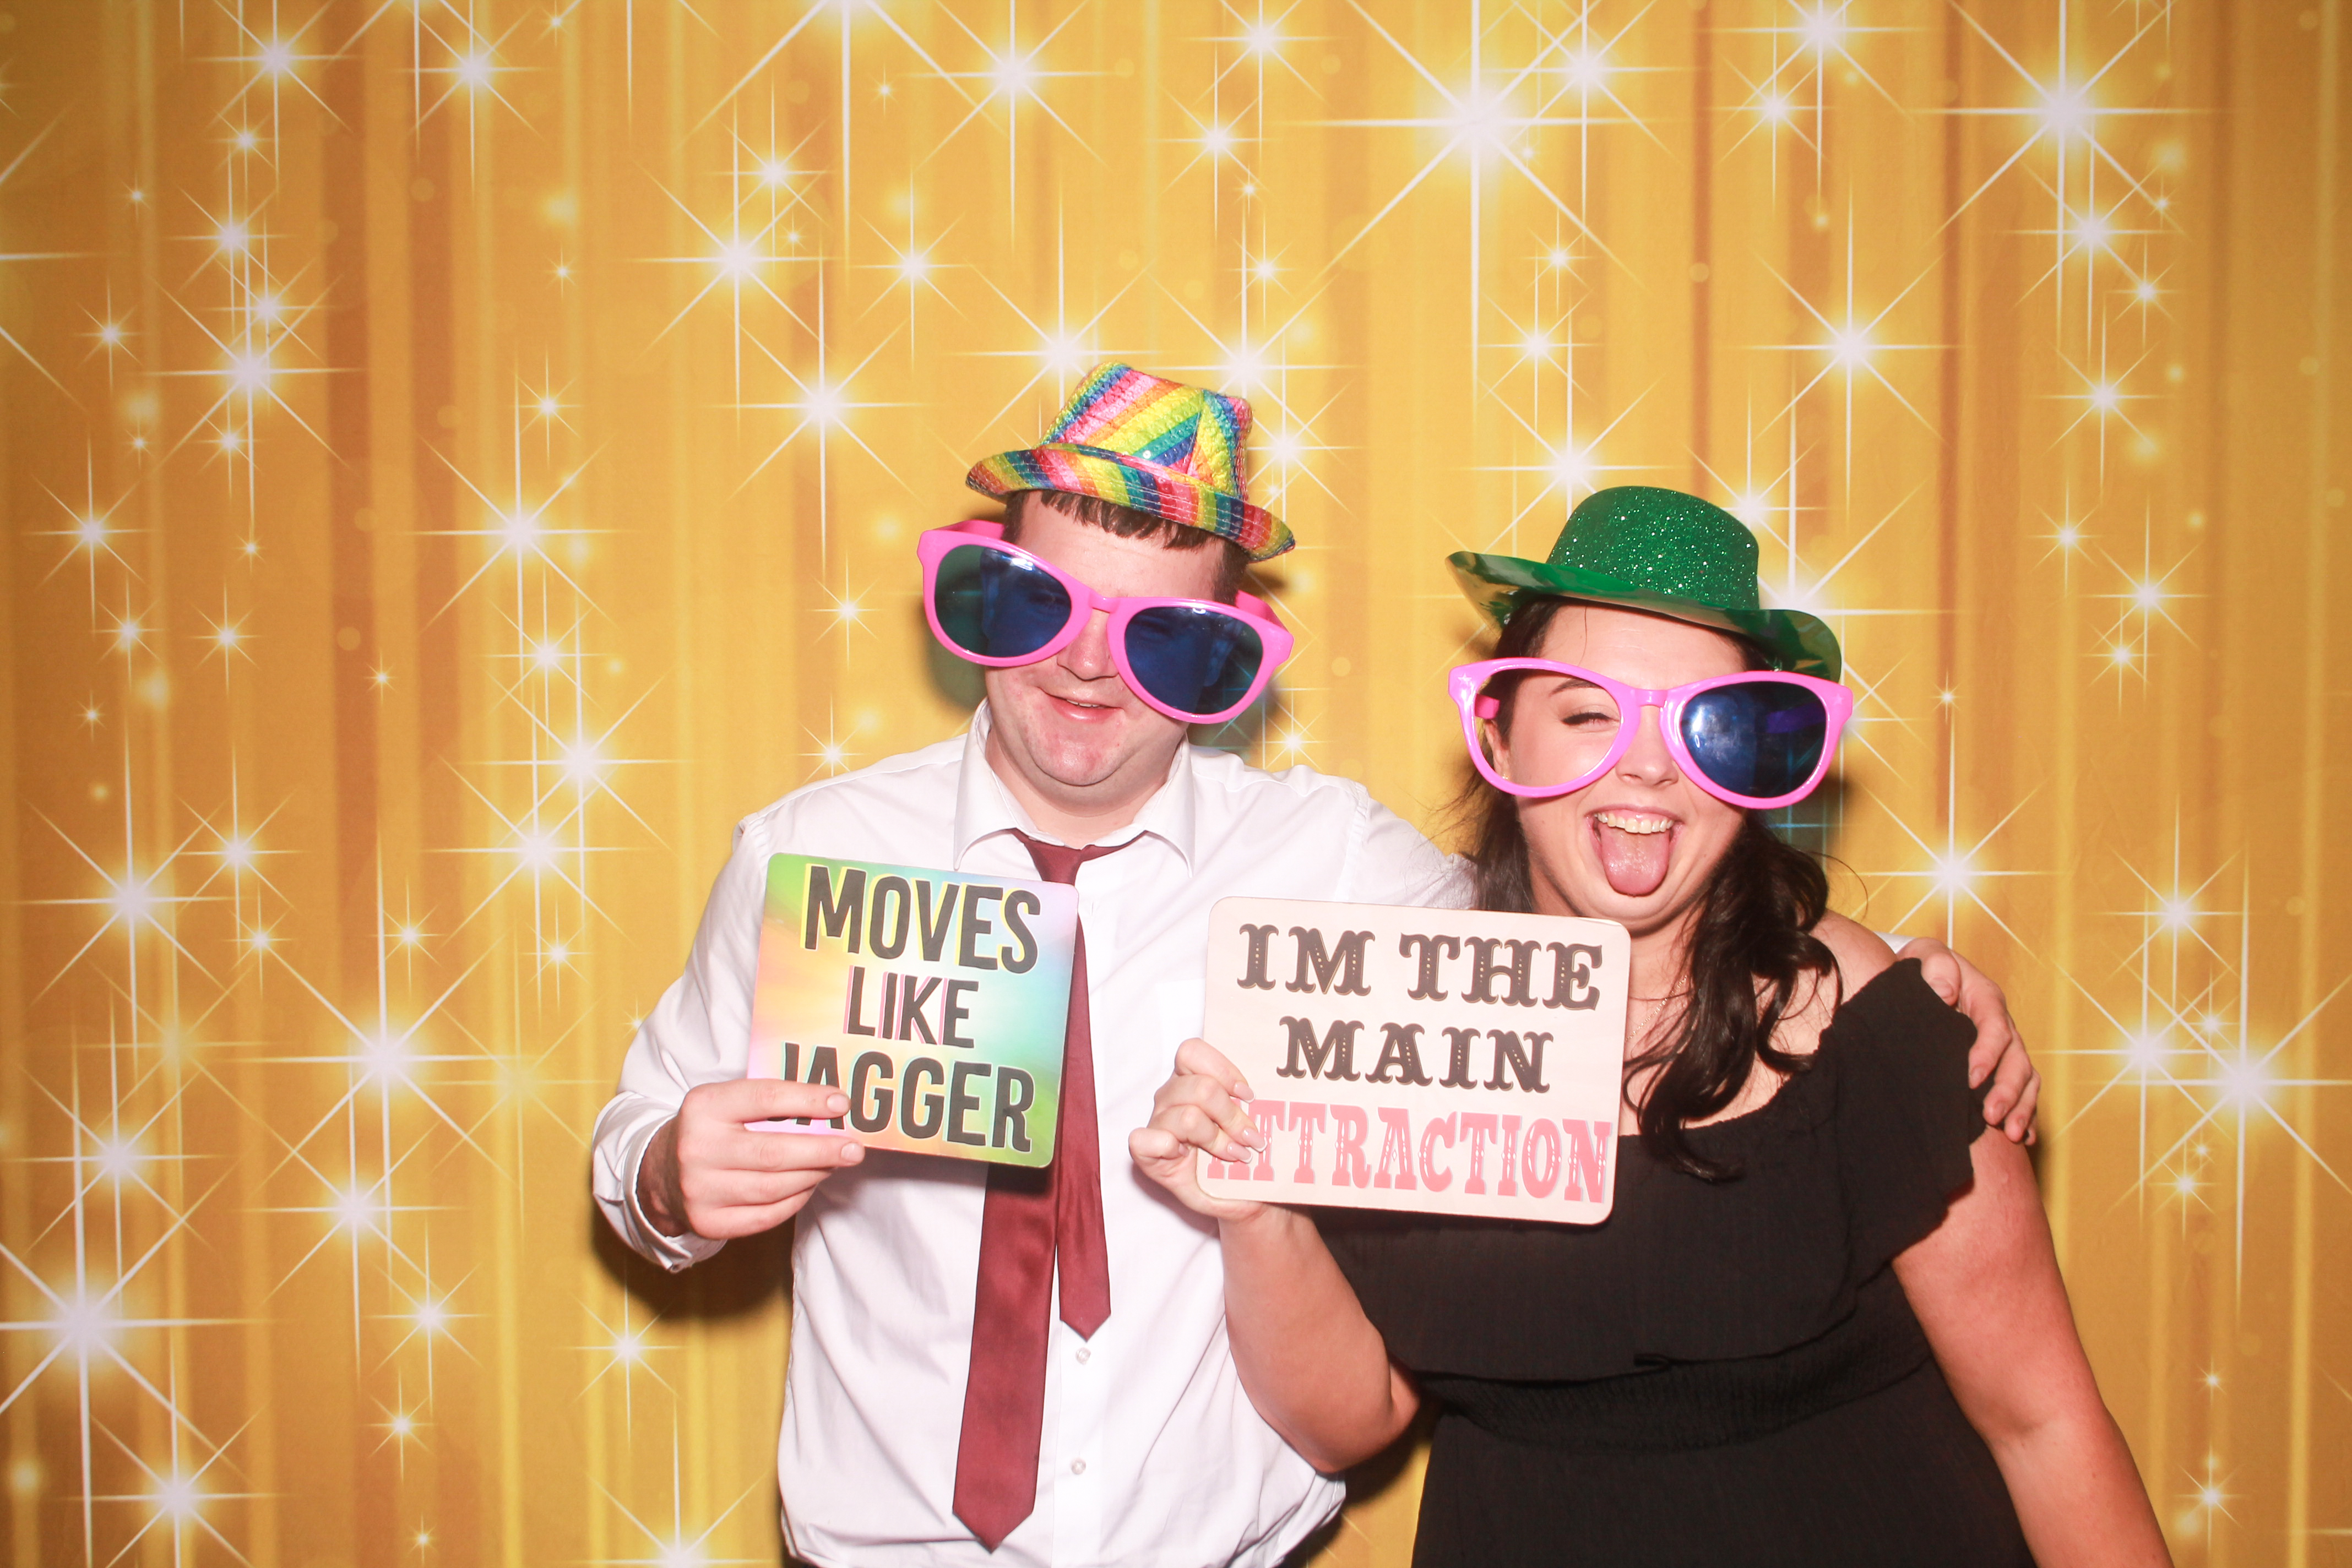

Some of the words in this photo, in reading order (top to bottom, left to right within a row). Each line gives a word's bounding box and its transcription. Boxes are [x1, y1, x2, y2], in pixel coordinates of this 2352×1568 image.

[800, 863, 1041, 974] MOVES
[843, 965, 979, 1049] LIKE
[1237, 923, 1376, 995] IM
[1399, 932, 1603, 1011] THE
[1276, 1016, 1554, 1093] MAIN
